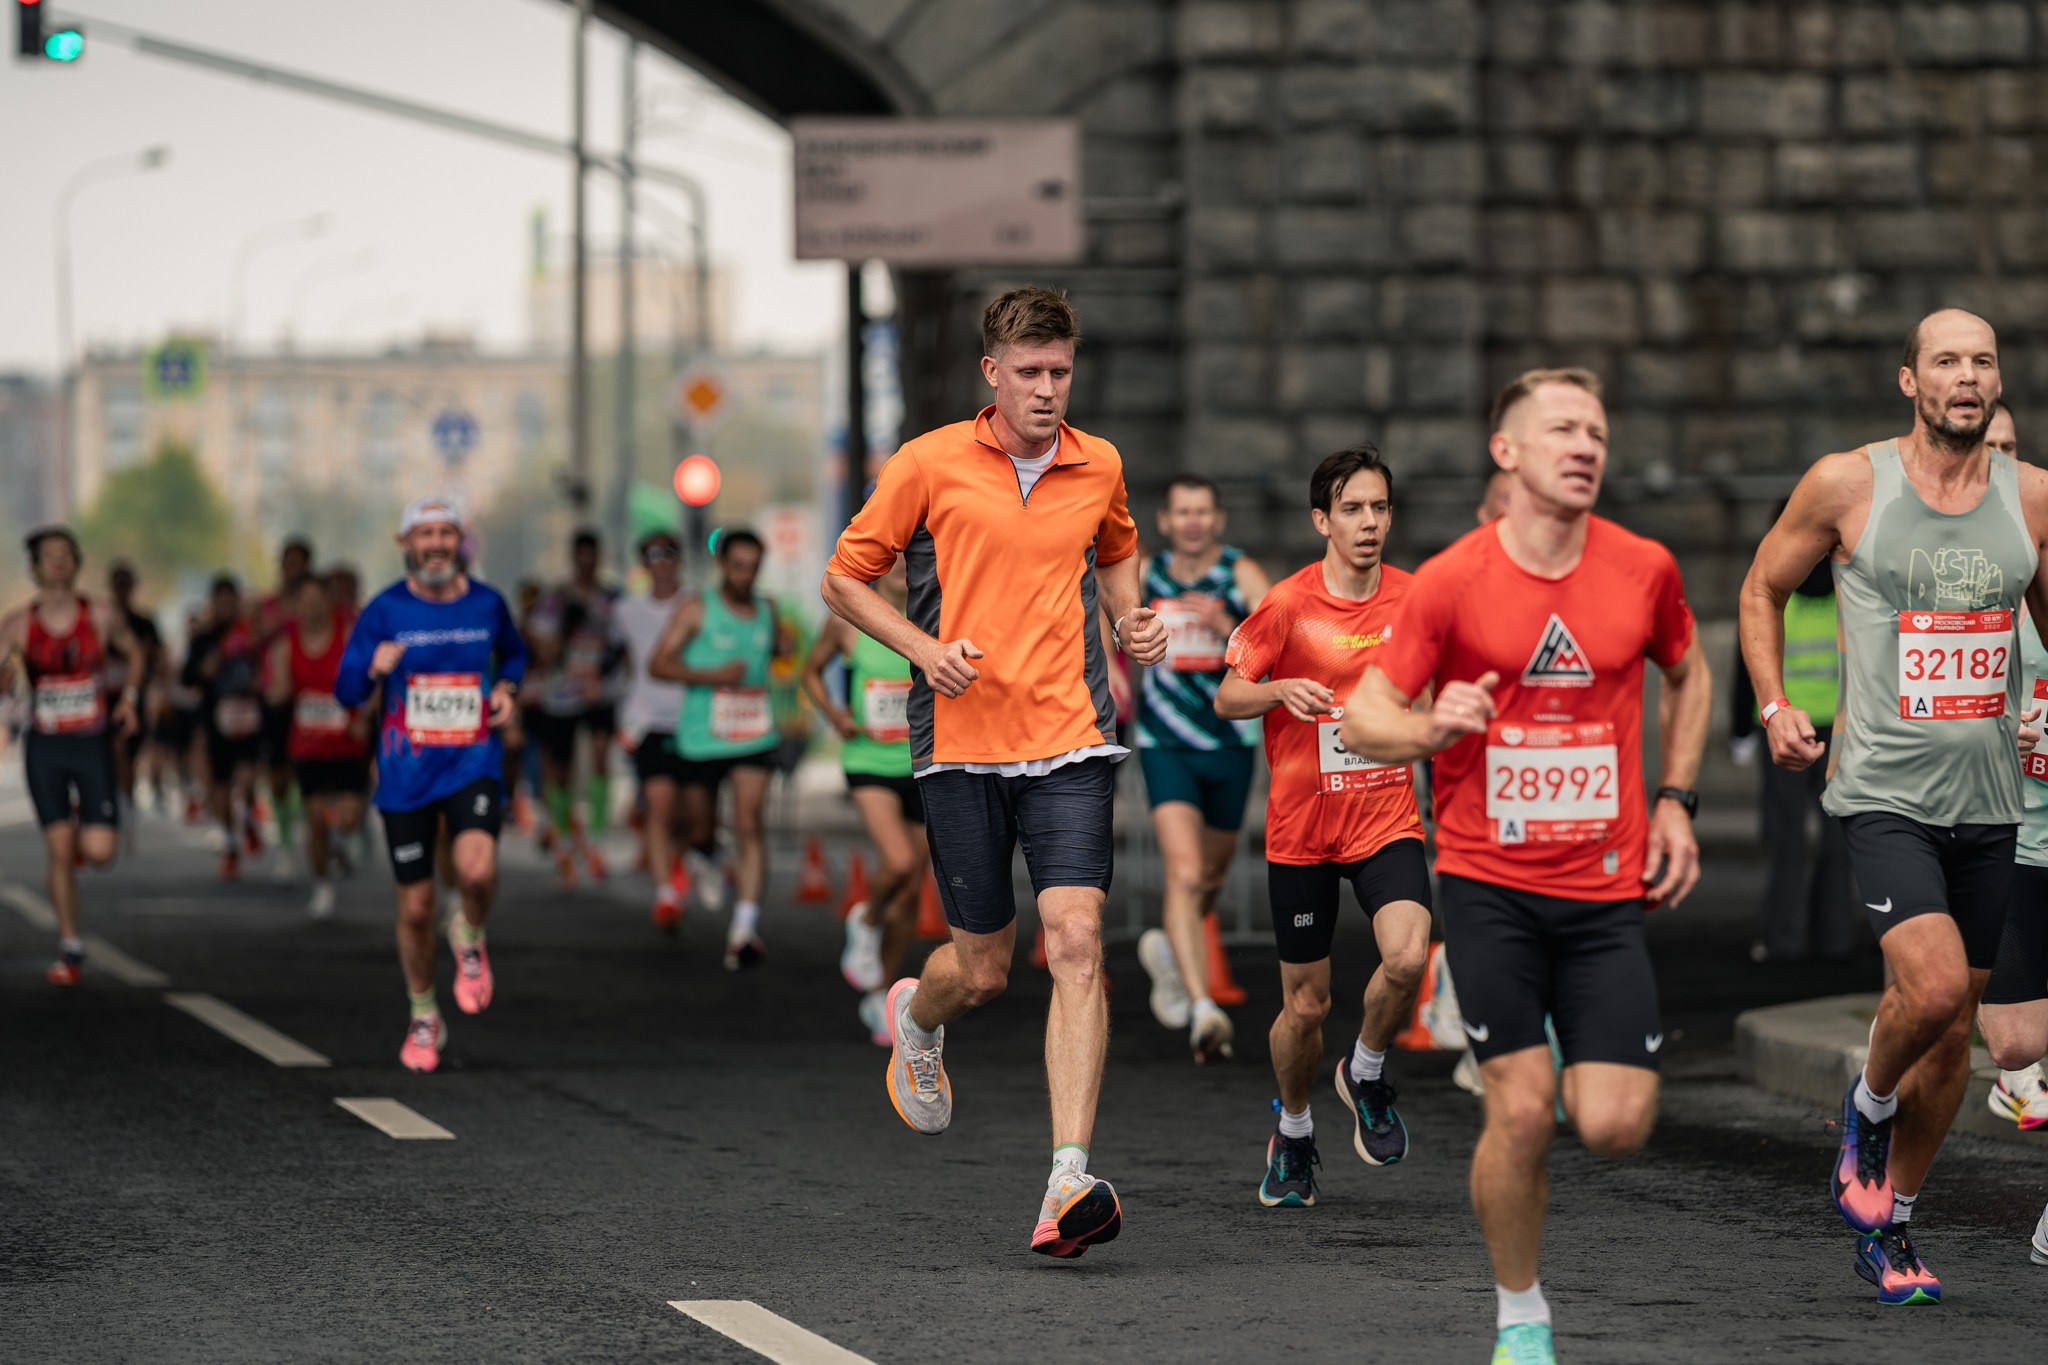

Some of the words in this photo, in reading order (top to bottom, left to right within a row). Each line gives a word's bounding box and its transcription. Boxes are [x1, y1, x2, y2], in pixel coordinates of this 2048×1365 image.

[1905, 646, 2007, 681] 32182
[1914, 697, 1929, 715] A
[1333, 728, 1349, 754] 3
[1344, 757, 1377, 766] ВЛАДИ
[2031, 756, 2046, 775] B
[1330, 774, 1345, 792] B
[1495, 765, 1612, 802] 28992
[1503, 820, 1519, 838] A
